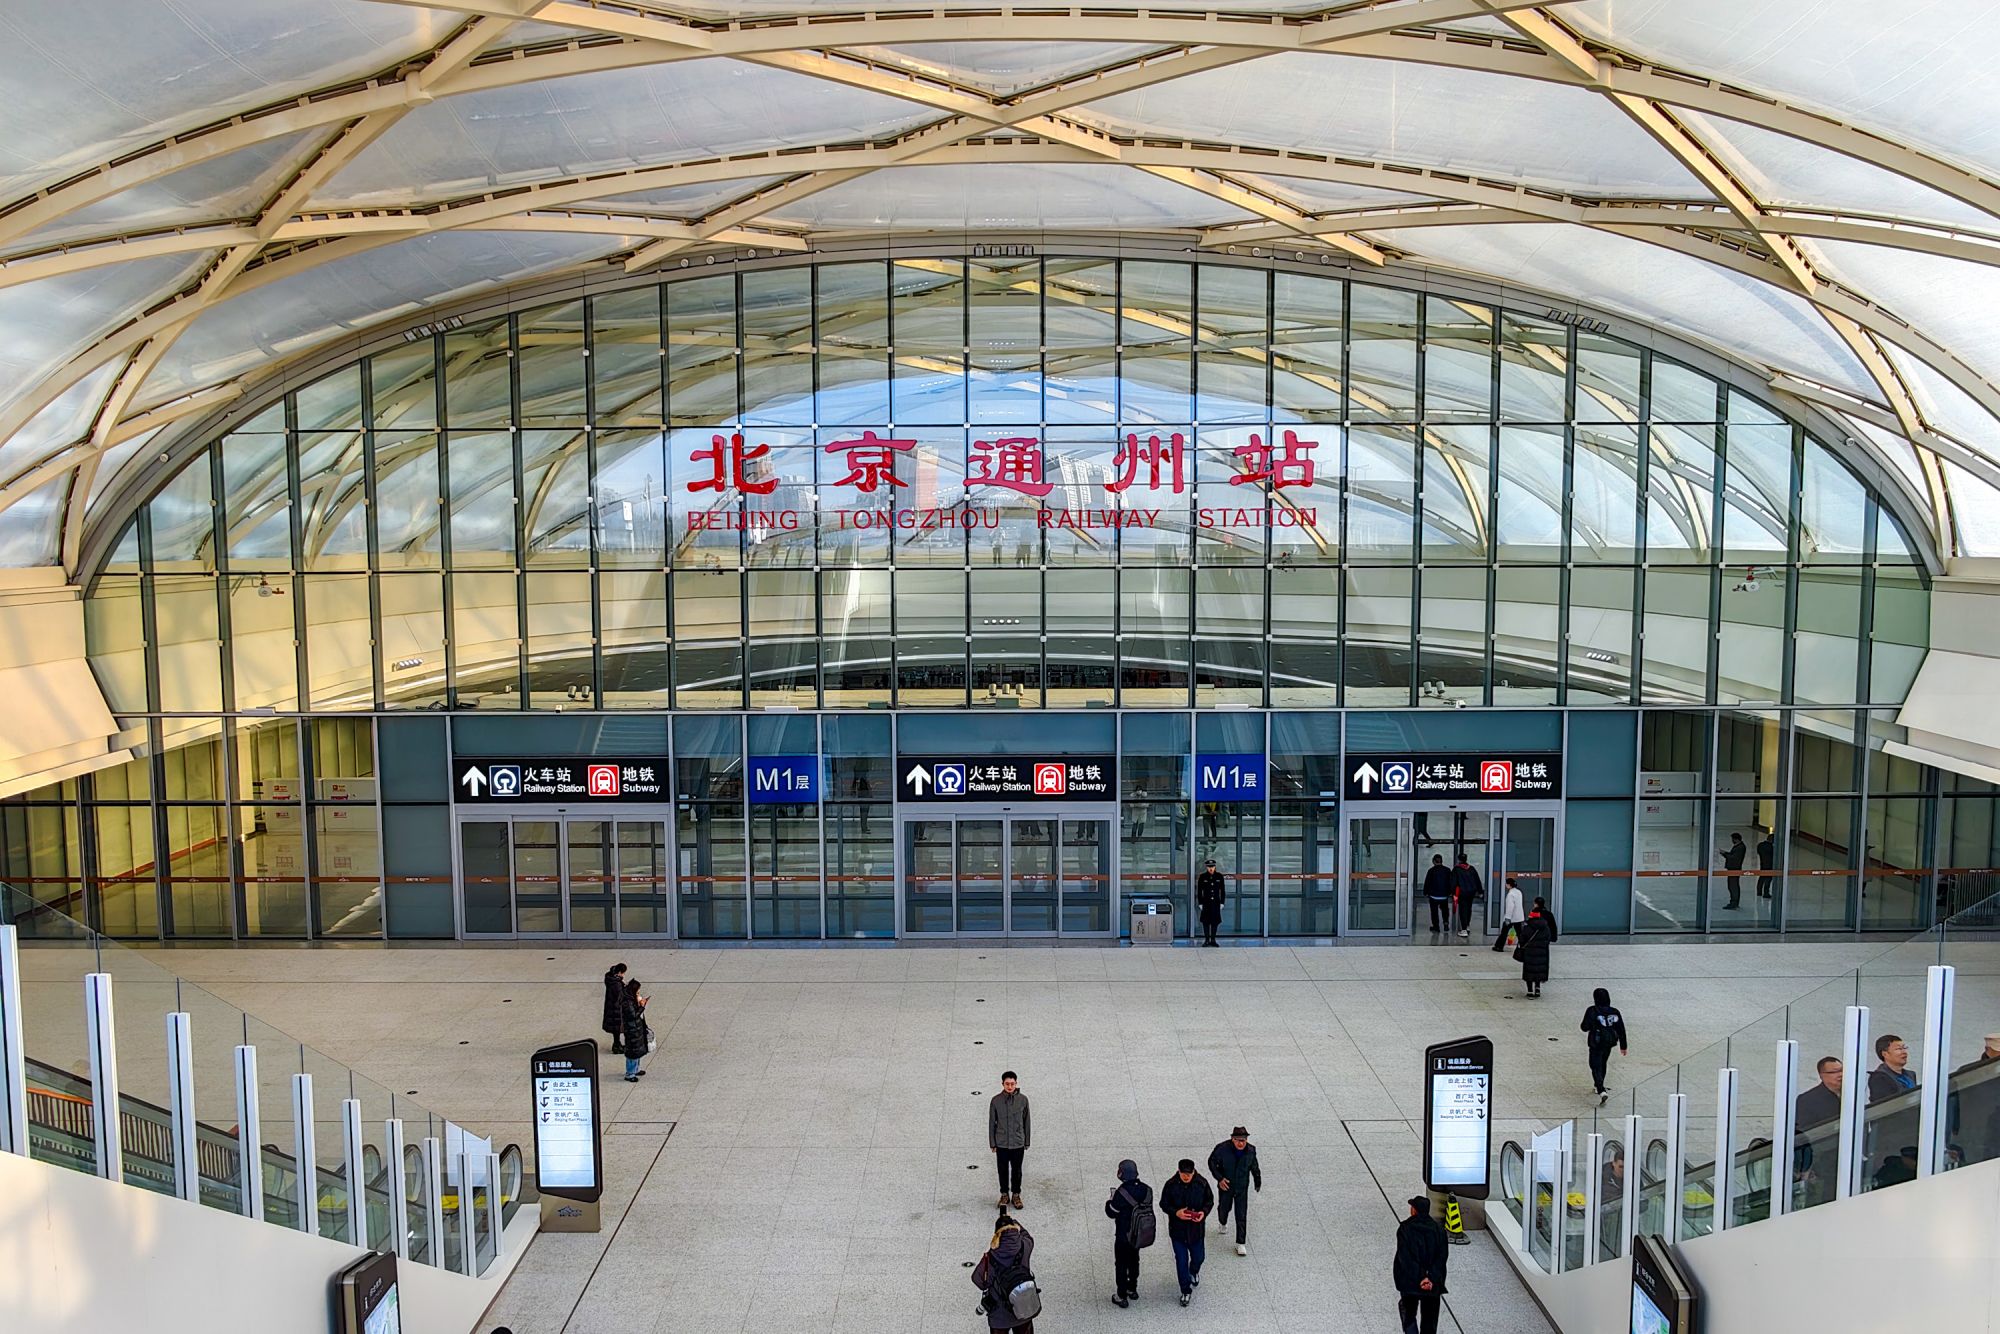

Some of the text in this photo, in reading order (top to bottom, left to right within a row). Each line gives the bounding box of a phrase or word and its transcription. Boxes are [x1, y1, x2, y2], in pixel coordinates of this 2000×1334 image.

[686, 430, 1319, 496] 北京通州站
[687, 507, 1317, 531] BEIJING TONGZHOU RAILWAY STATION
[524, 767, 571, 782] 火车站
[622, 766, 655, 781] 地铁
[969, 765, 1017, 780] 火车站
[1068, 765, 1101, 780] 地铁
[1203, 765, 1257, 789] M1层
[1416, 763, 1464, 779] 火车站
[1515, 762, 1547, 778] 地铁
[756, 767, 810, 791] M1层
[1415, 780, 1478, 791] Railway Station
[1514, 780, 1552, 790] Subway
[523, 784, 586, 794] Railway Station
[622, 783, 660, 794] Subway
[968, 782, 1031, 793] Railway Station
[1068, 782, 1107, 792] Subway
